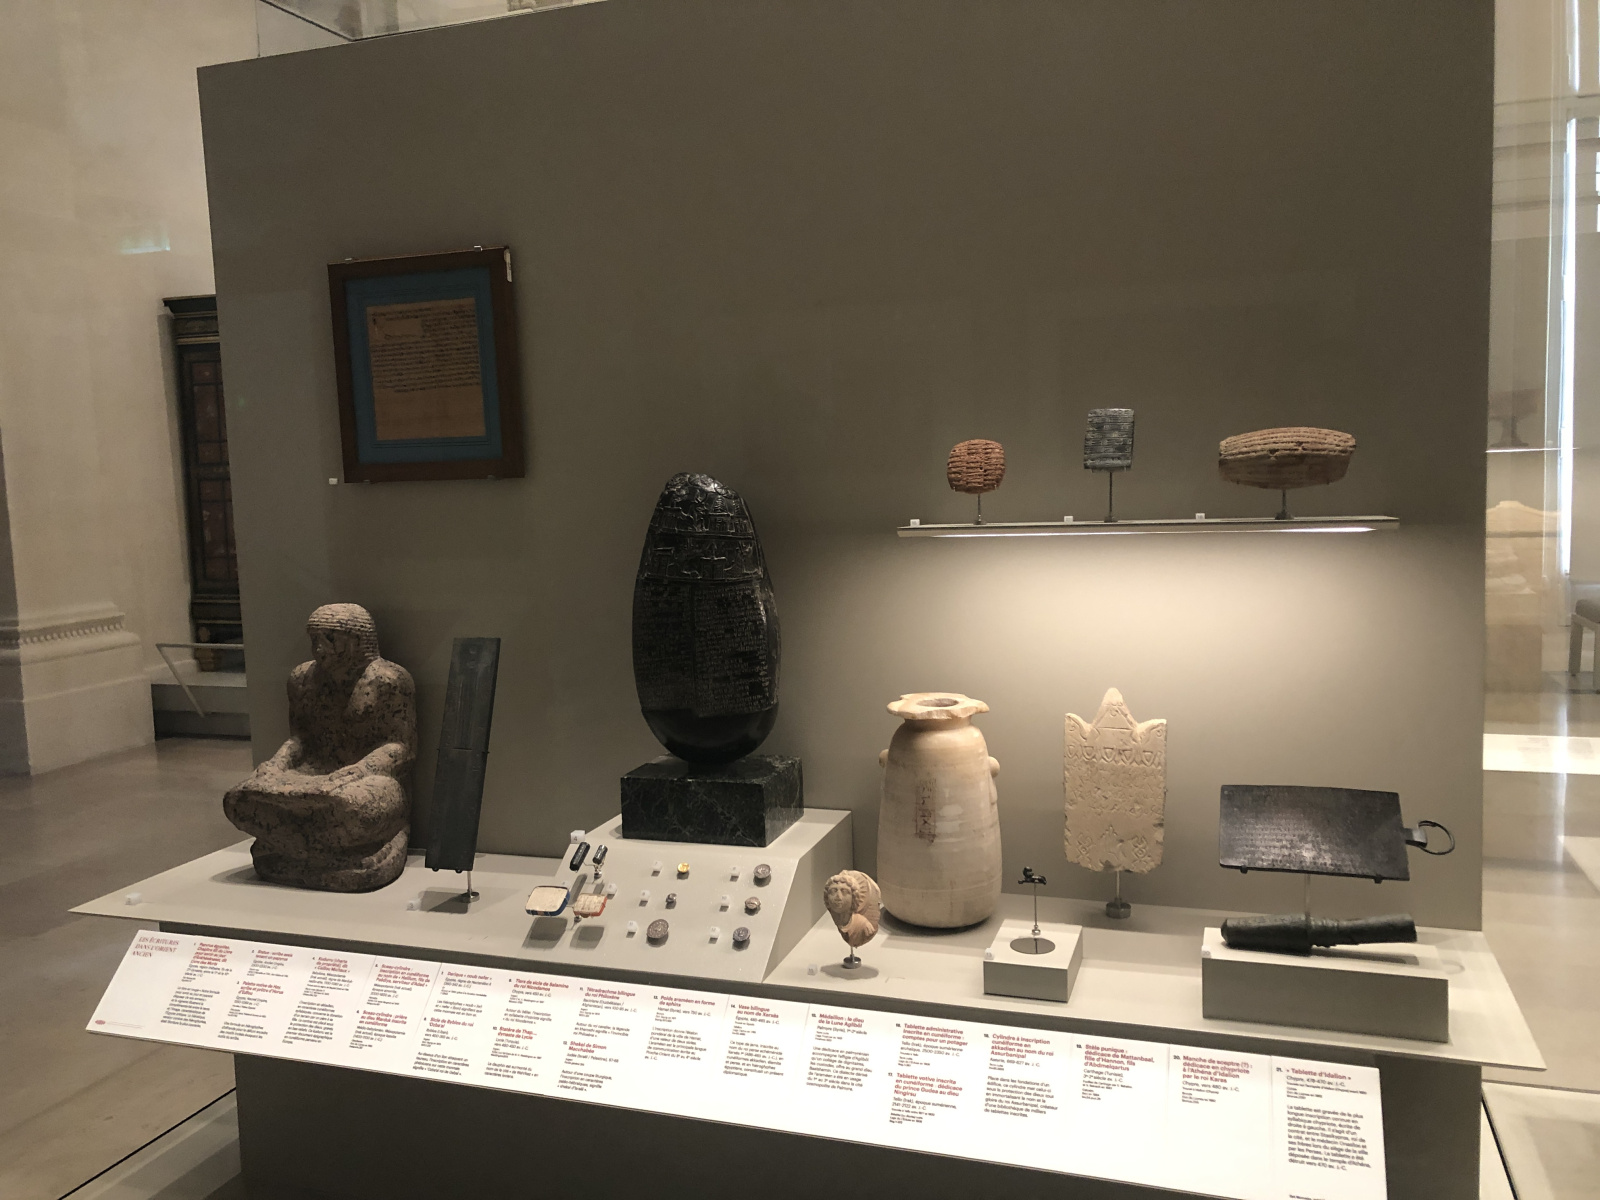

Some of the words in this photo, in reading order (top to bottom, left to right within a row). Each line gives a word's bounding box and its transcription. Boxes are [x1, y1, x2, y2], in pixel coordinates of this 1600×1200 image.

[904, 1023, 926, 1031] Tablette
[925, 1026, 964, 1036] administrative
[931, 1032, 962, 1040] cunéiforme
[992, 1033, 1016, 1042] Cylindre
[1020, 1037, 1051, 1046] inscription
[992, 1039, 1023, 1048] cunéiforme
[991, 1049, 1027, 1060] Assurbanipal
[1084, 1049, 1111, 1058] dédicace
[1183, 1055, 1207, 1063] Manche
[1216, 1059, 1240, 1068] sceptre
[1182, 1061, 1211, 1070] dédicace
[1220, 1066, 1250, 1075] chypriote
[1291, 1068, 1317, 1077] Tablette
[897, 1072, 918, 1080] Tablette
[936, 1077, 956, 1085] inscrite
[902, 1085, 920, 1093] prince
[903, 1079, 934, 1088] cunéiforme
[937, 1083, 963, 1092] dédicace
